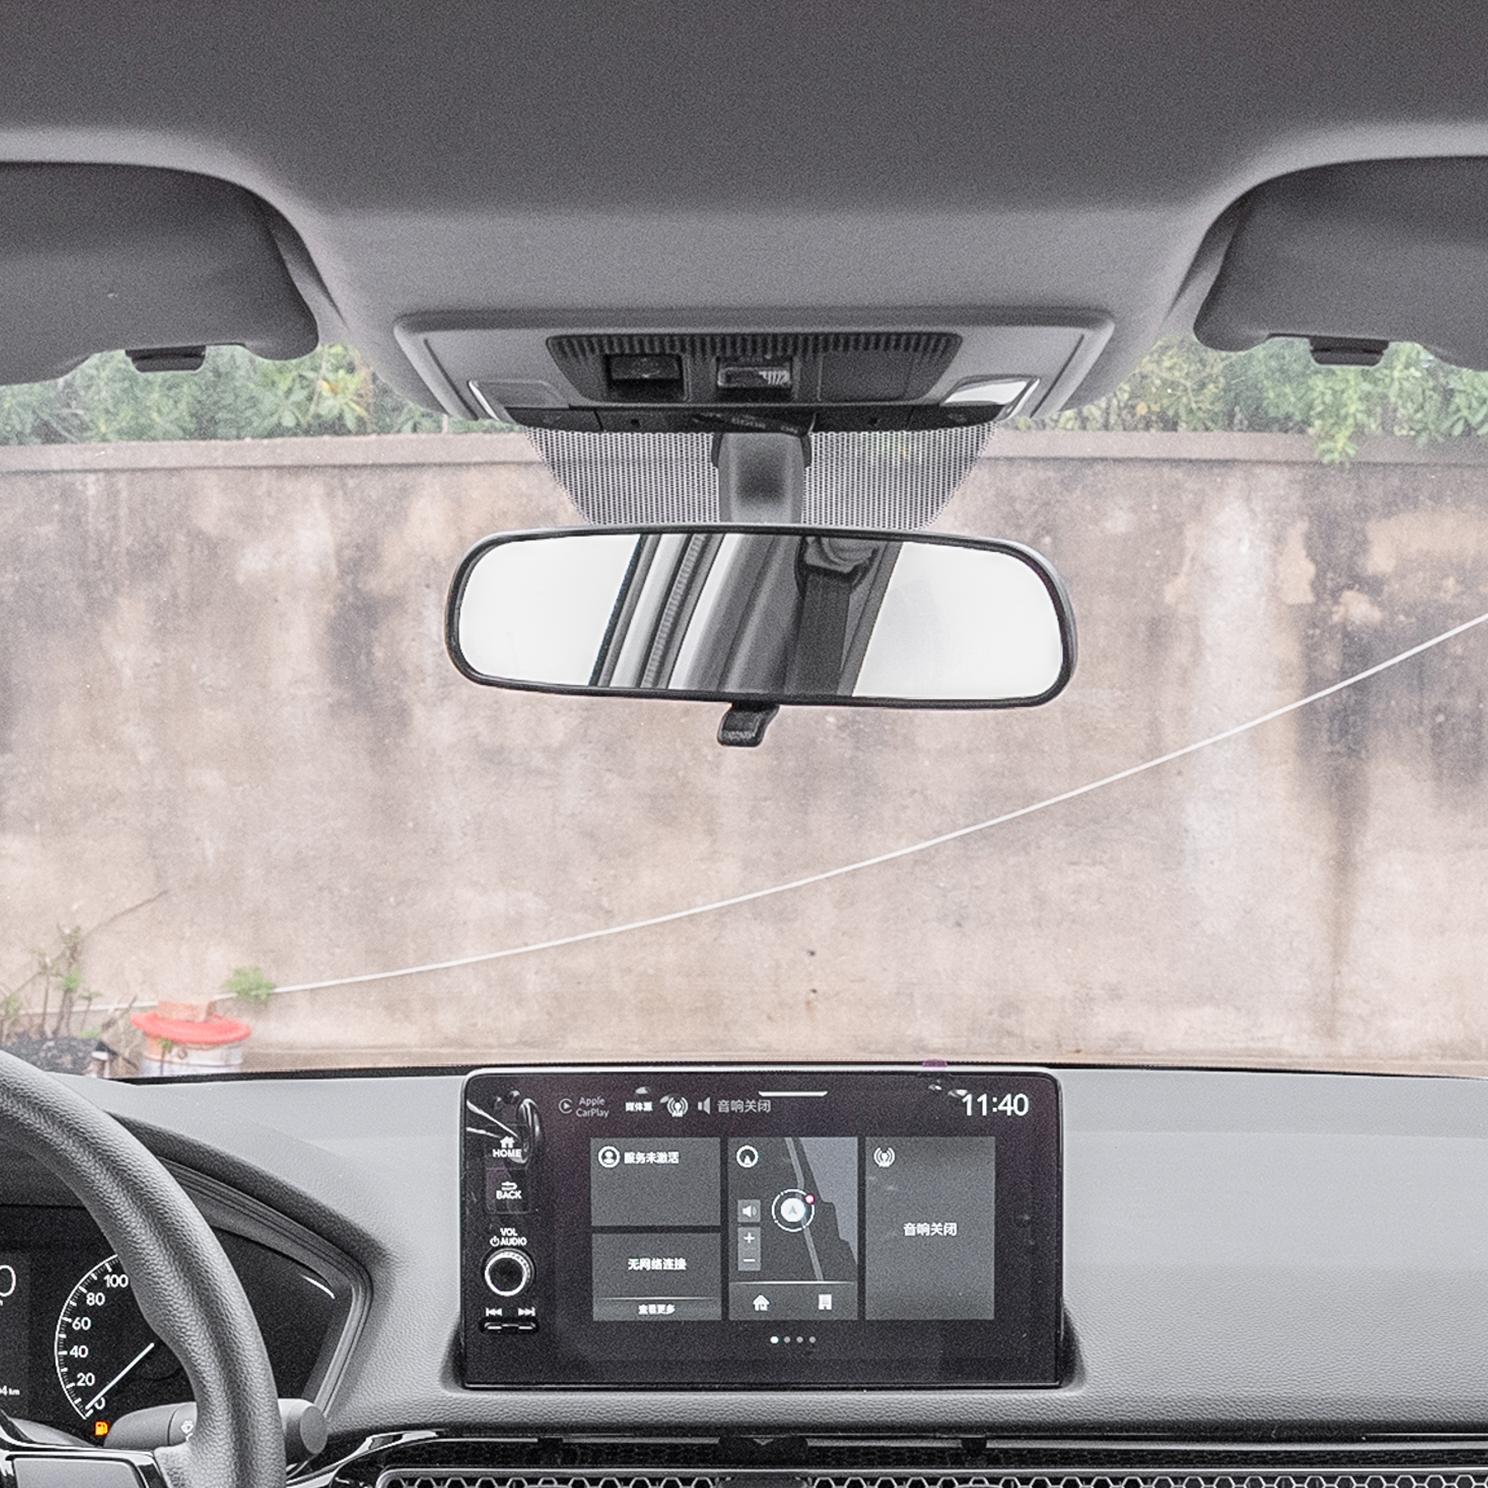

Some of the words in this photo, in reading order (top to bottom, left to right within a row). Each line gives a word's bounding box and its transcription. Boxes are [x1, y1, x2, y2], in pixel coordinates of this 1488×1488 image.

[579, 1095, 605, 1107] Apple
[717, 1099, 772, 1113] 音响关闭
[962, 1093, 1029, 1116] 11:40
[576, 1107, 610, 1118] CarPlay
[492, 1149, 522, 1158] HOME
[496, 1190, 522, 1199] BACK
[500, 1228, 518, 1236] VOL
[903, 1222, 958, 1236] 音响关闭
[500, 1236, 527, 1246] AUDIO
[627, 1257, 687, 1271] 无网络连接
[103, 1274, 129, 1288] 100
[86, 1293, 105, 1306] 80
[72, 1317, 91, 1330] 60
[69, 1346, 89, 1358] 40
[77, 1373, 95, 1386] 20
